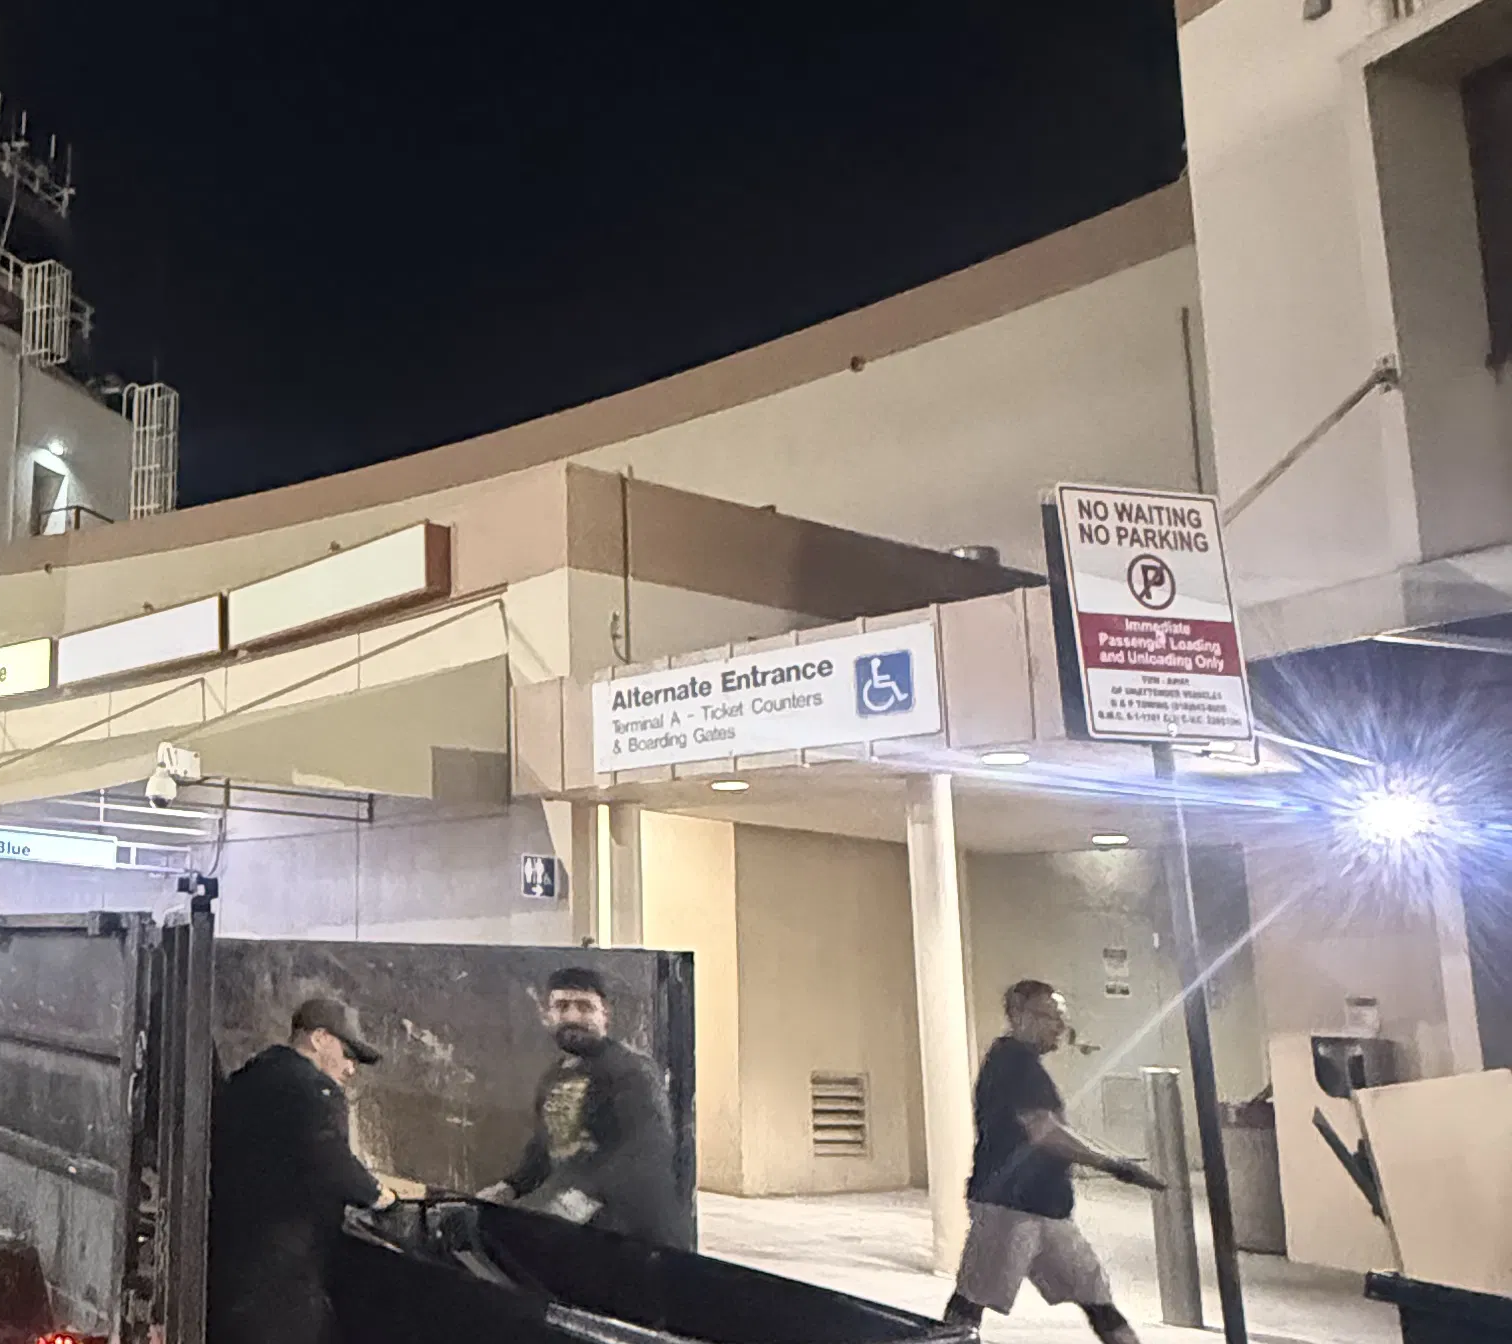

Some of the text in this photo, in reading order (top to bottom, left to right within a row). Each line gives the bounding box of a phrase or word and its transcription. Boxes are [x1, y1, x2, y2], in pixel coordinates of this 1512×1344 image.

[1077, 499, 1202, 529] NO WAITING
[1078, 523, 1209, 553] NO PARKING
[1125, 618, 1191, 635] Immediate
[1098, 632, 1222, 656] Passenger Loading
[1100, 650, 1224, 672] and Unloading Only
[612, 659, 834, 711] Alternate Entrance
[612, 713, 664, 734] Terminal
[670, 711, 681, 727] A
[701, 702, 744, 721] Ticket
[751, 691, 823, 714] Counters
[612, 726, 736, 754] & Boarding Gates
